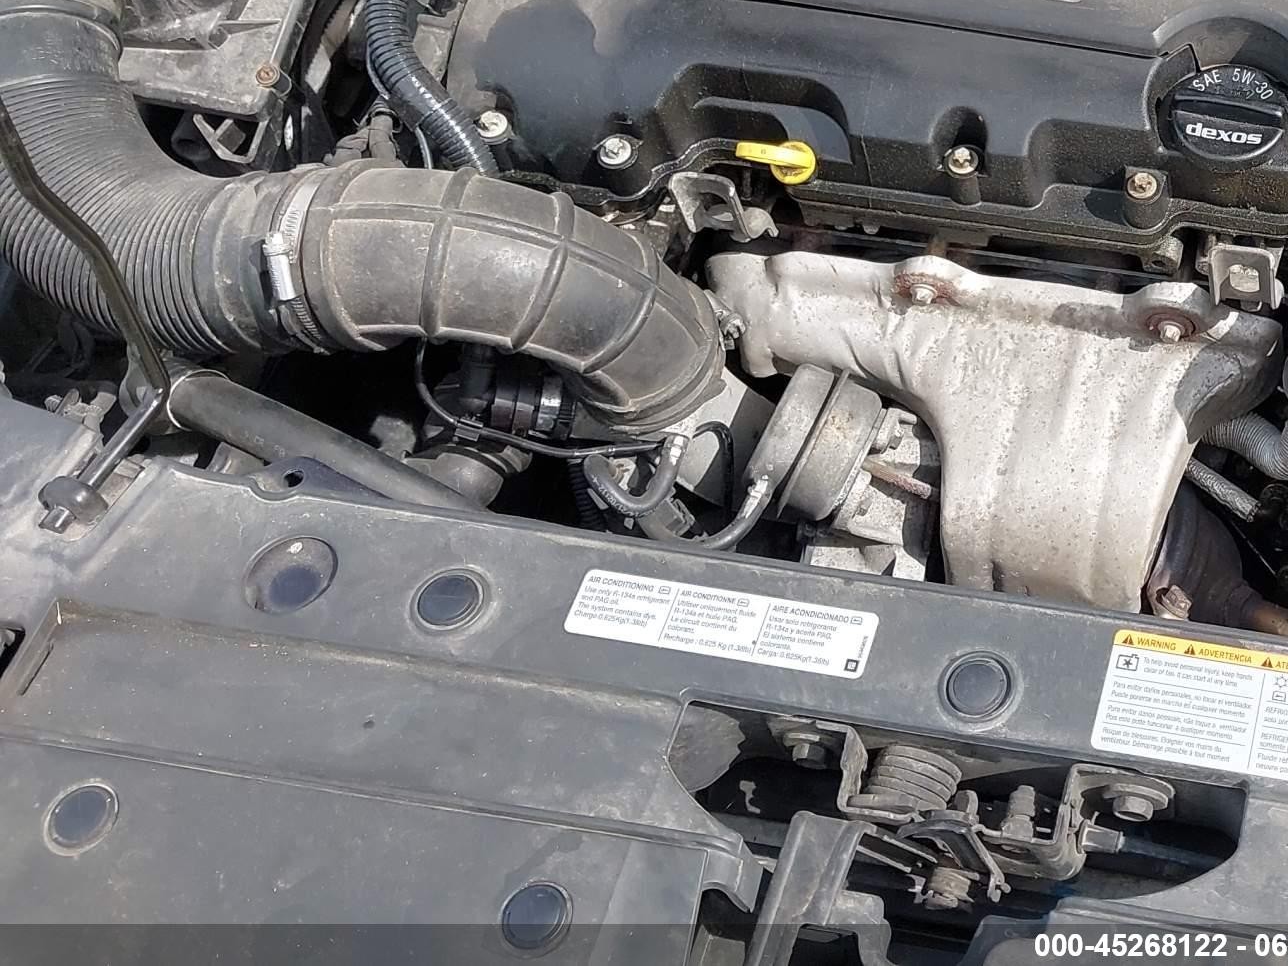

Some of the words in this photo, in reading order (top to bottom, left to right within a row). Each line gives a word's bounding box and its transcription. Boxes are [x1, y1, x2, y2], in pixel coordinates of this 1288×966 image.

[1193, 70, 1222, 92] SAE
[1232, 68, 1274, 101] 5W-30
[1185, 122, 1263, 145] dexos
[597, 588, 612, 596] only
[601, 578, 654, 591] CONDITIONING
[591, 604, 614, 613] system
[614, 608, 642, 616] contains
[772, 605, 788, 613] AIRE
[789, 608, 849, 622] ACONDICIONADO
[1137, 638, 1176, 649] WARNING
[1199, 648, 1252, 662] ADVERTENCIA
